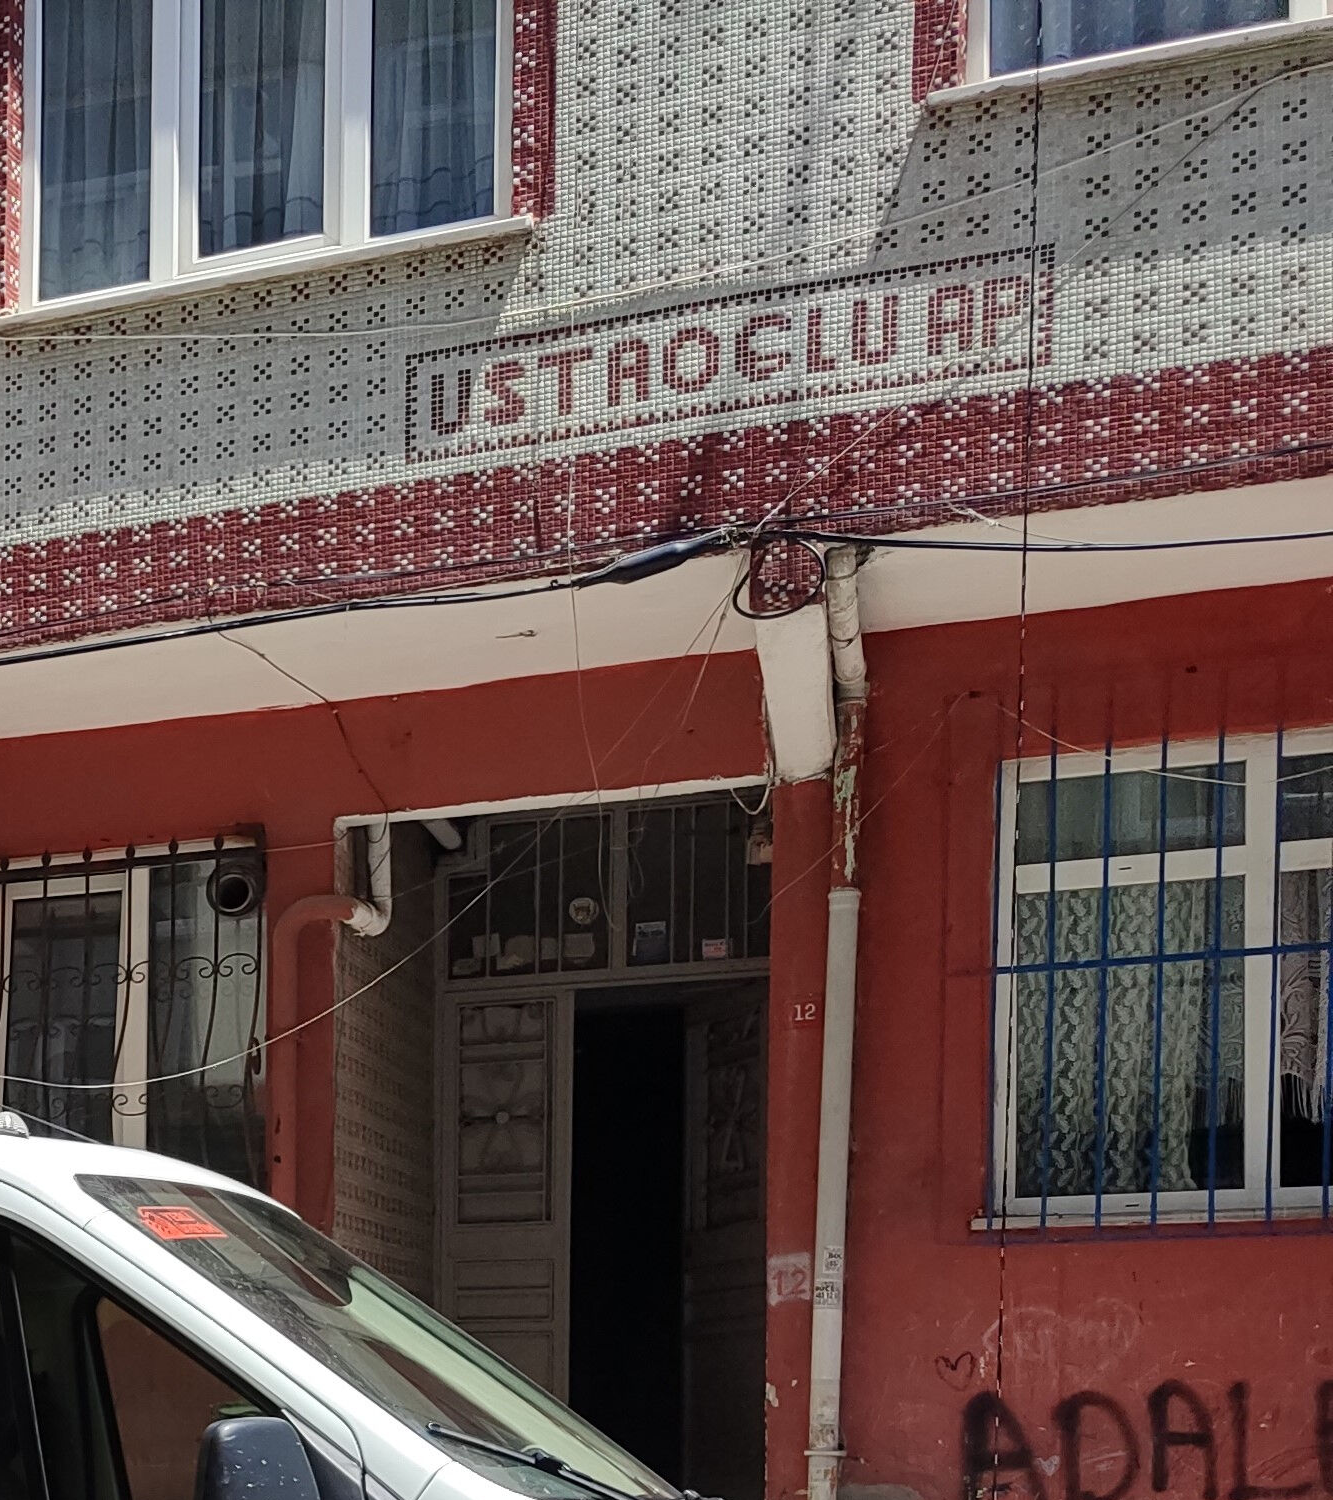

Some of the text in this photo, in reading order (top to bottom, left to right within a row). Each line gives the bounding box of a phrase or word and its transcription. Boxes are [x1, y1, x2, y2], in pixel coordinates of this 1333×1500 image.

[927, 275, 1030, 356] AP
[793, 1003, 816, 1021] 12
[771, 1266, 809, 1297] 12
